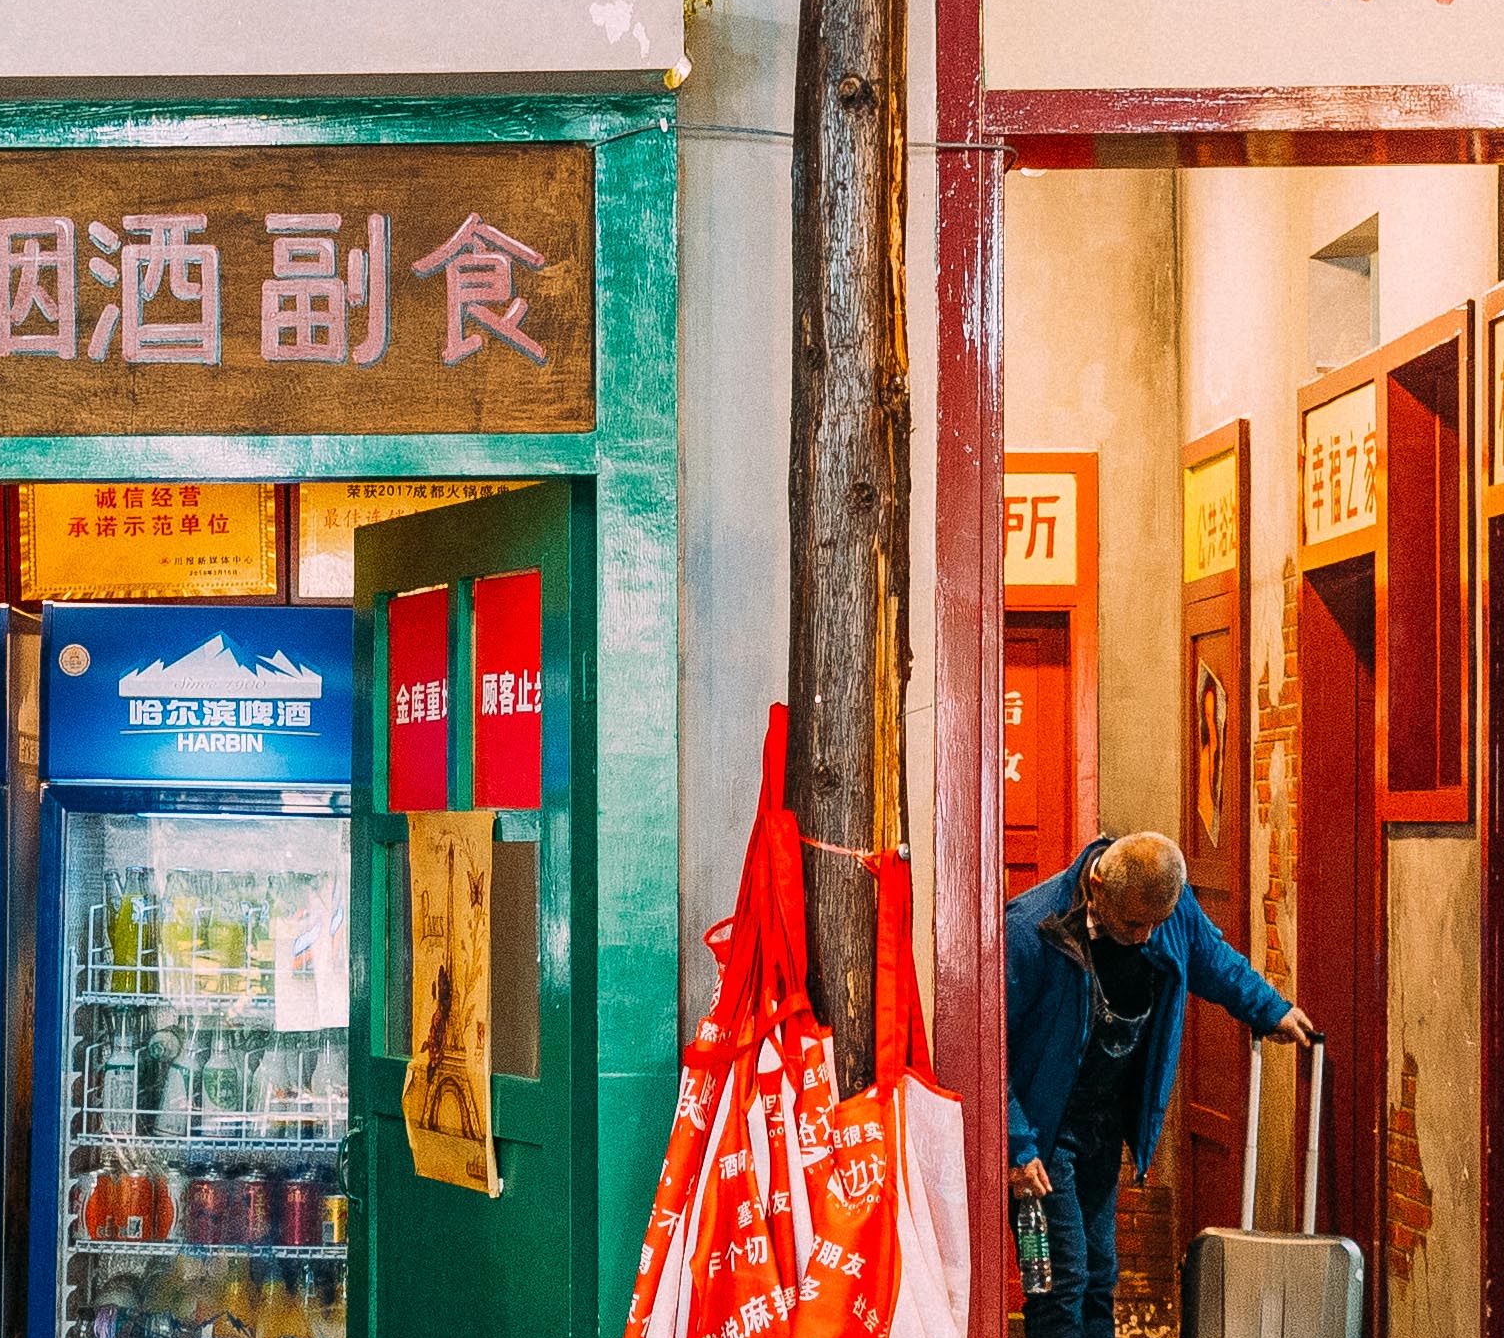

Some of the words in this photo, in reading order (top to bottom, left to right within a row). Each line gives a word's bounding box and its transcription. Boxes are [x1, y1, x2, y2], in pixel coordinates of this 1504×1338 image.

[94, 485, 202, 509] 诚信经营
[68, 514, 230, 537] 承诺示范单位
[128, 699, 311, 727] 哈尔滨啤酒
[176, 733, 263, 753] HARBIN
